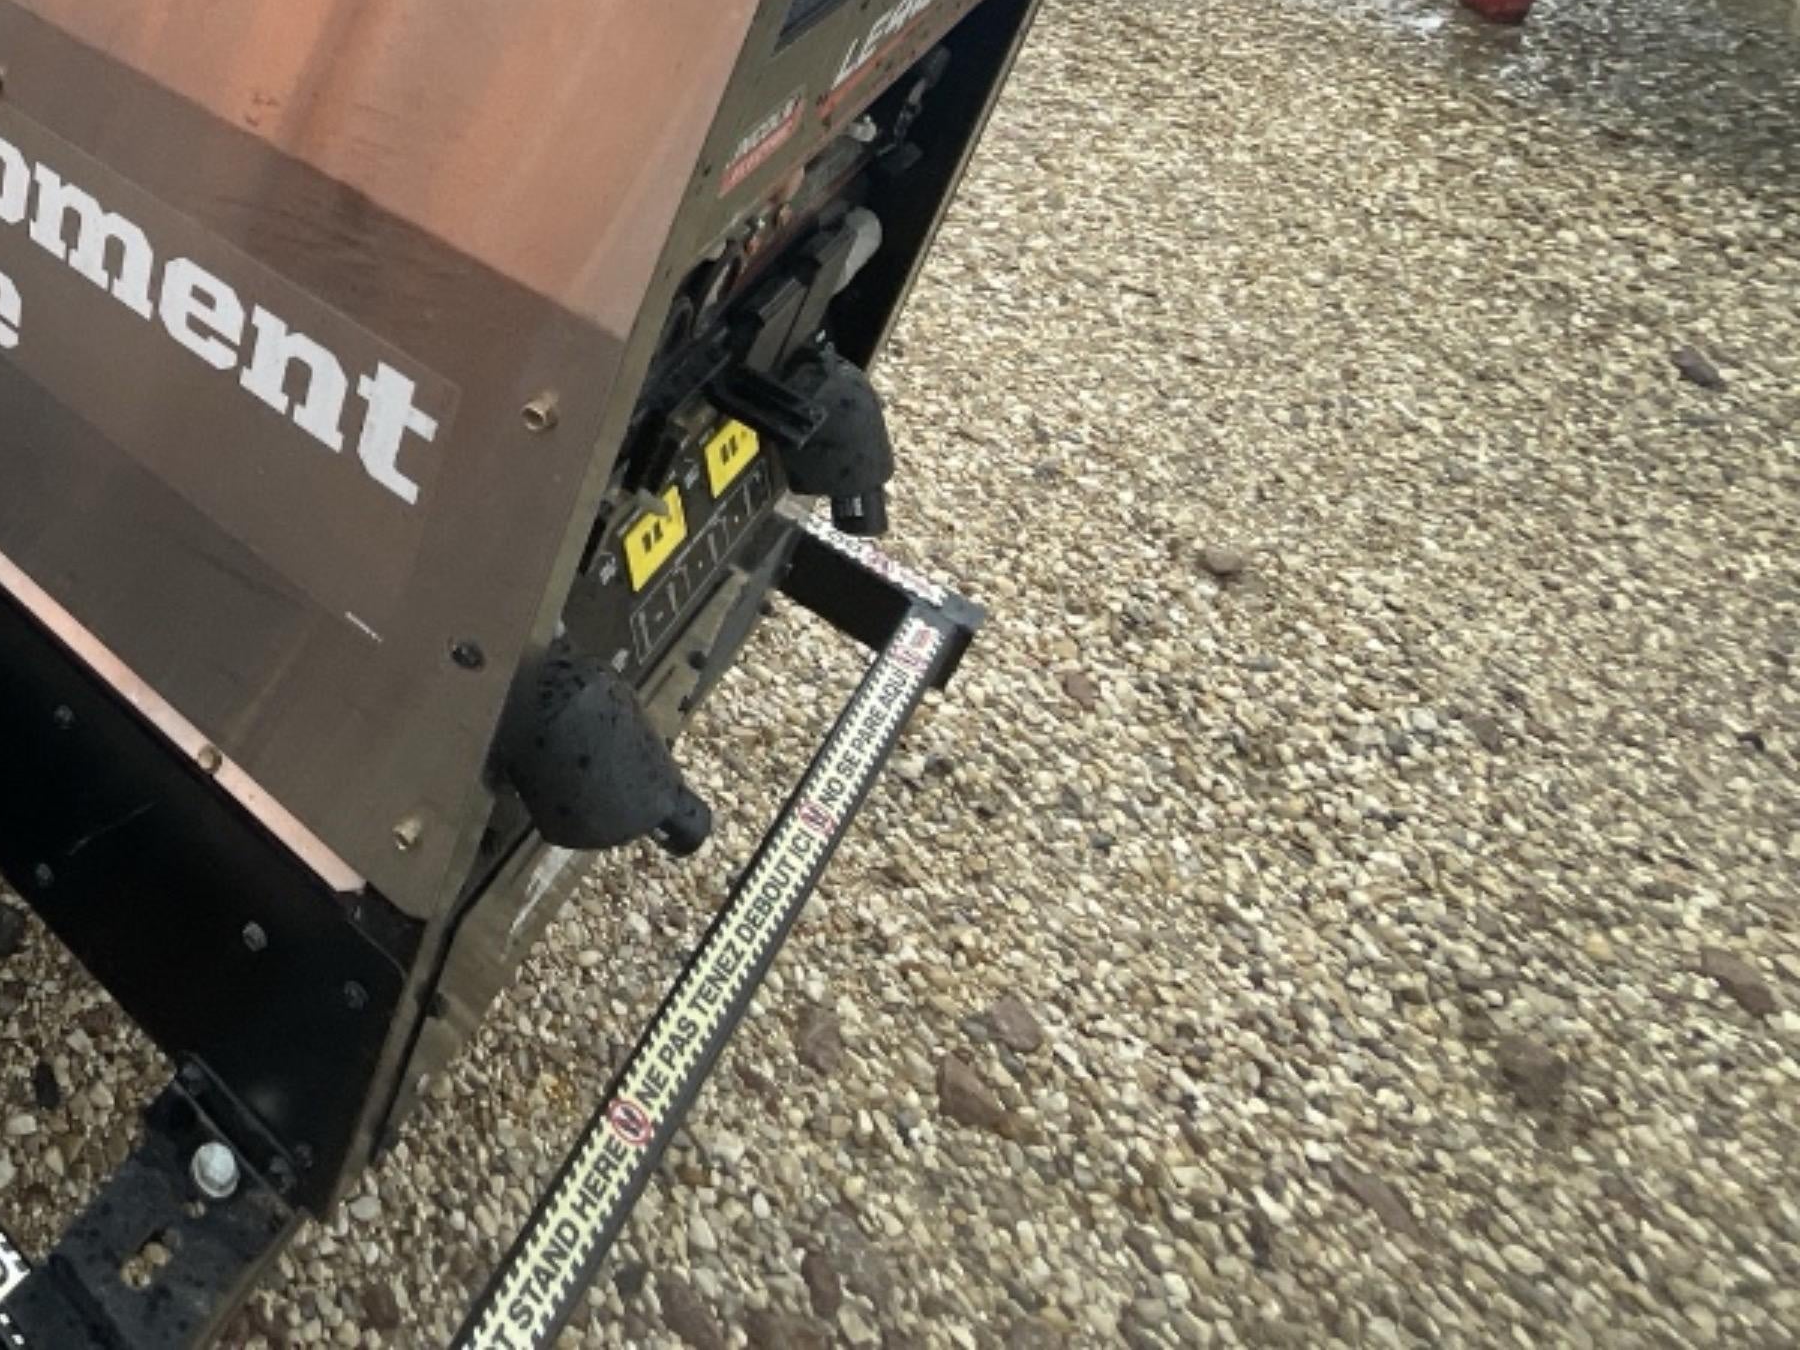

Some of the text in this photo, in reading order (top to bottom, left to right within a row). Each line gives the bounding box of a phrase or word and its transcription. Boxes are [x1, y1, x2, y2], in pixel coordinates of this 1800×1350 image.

[819, 778, 845, 808] NO
[837, 753, 862, 776] SE
[852, 708, 887, 752] PARE
[635, 832, 817, 1110] NE PAS TENEZ DEBOUT ICI
[506, 1137, 628, 1331] STAND HERE
